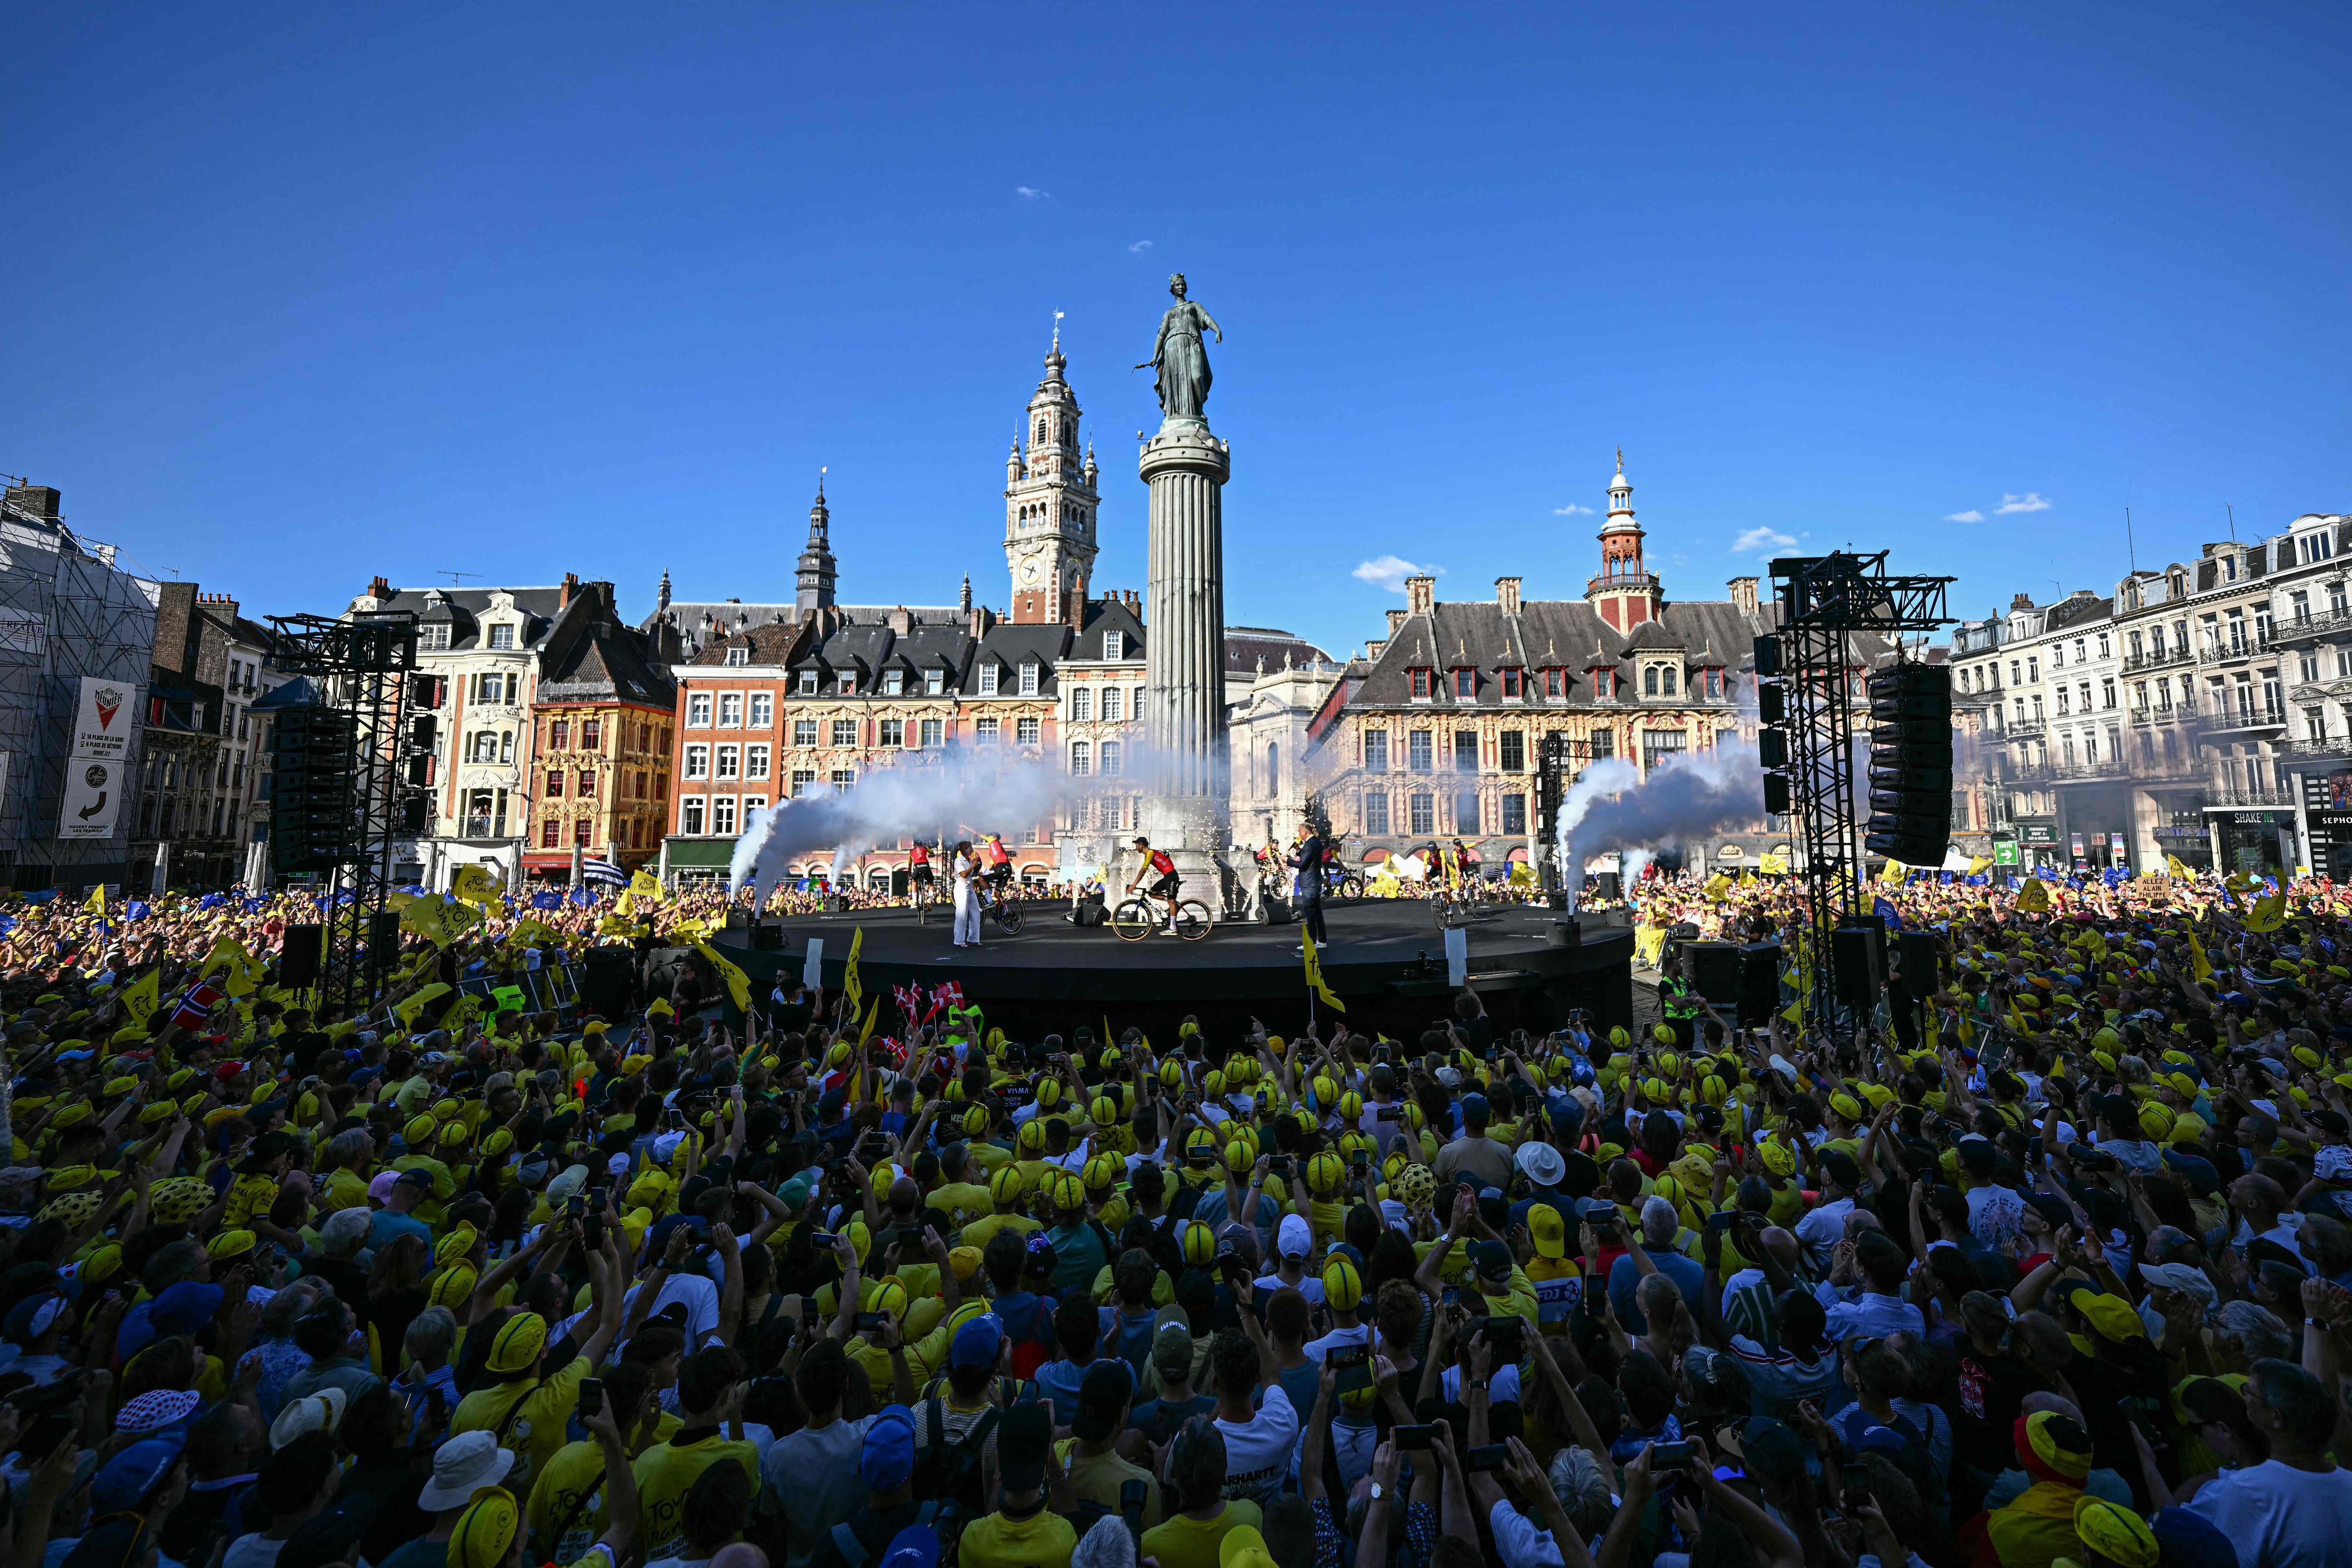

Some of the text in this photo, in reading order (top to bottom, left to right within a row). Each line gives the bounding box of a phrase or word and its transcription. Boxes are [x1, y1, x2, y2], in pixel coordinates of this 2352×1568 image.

[95, 689, 123, 708] MEUNIER
[1154, 856, 1167, 866] Cofidis
[1537, 1288, 1559, 1303] FDJ
[1223, 1465, 1279, 1485] ARHARTT
[494, 1530, 504, 1549] LCL
